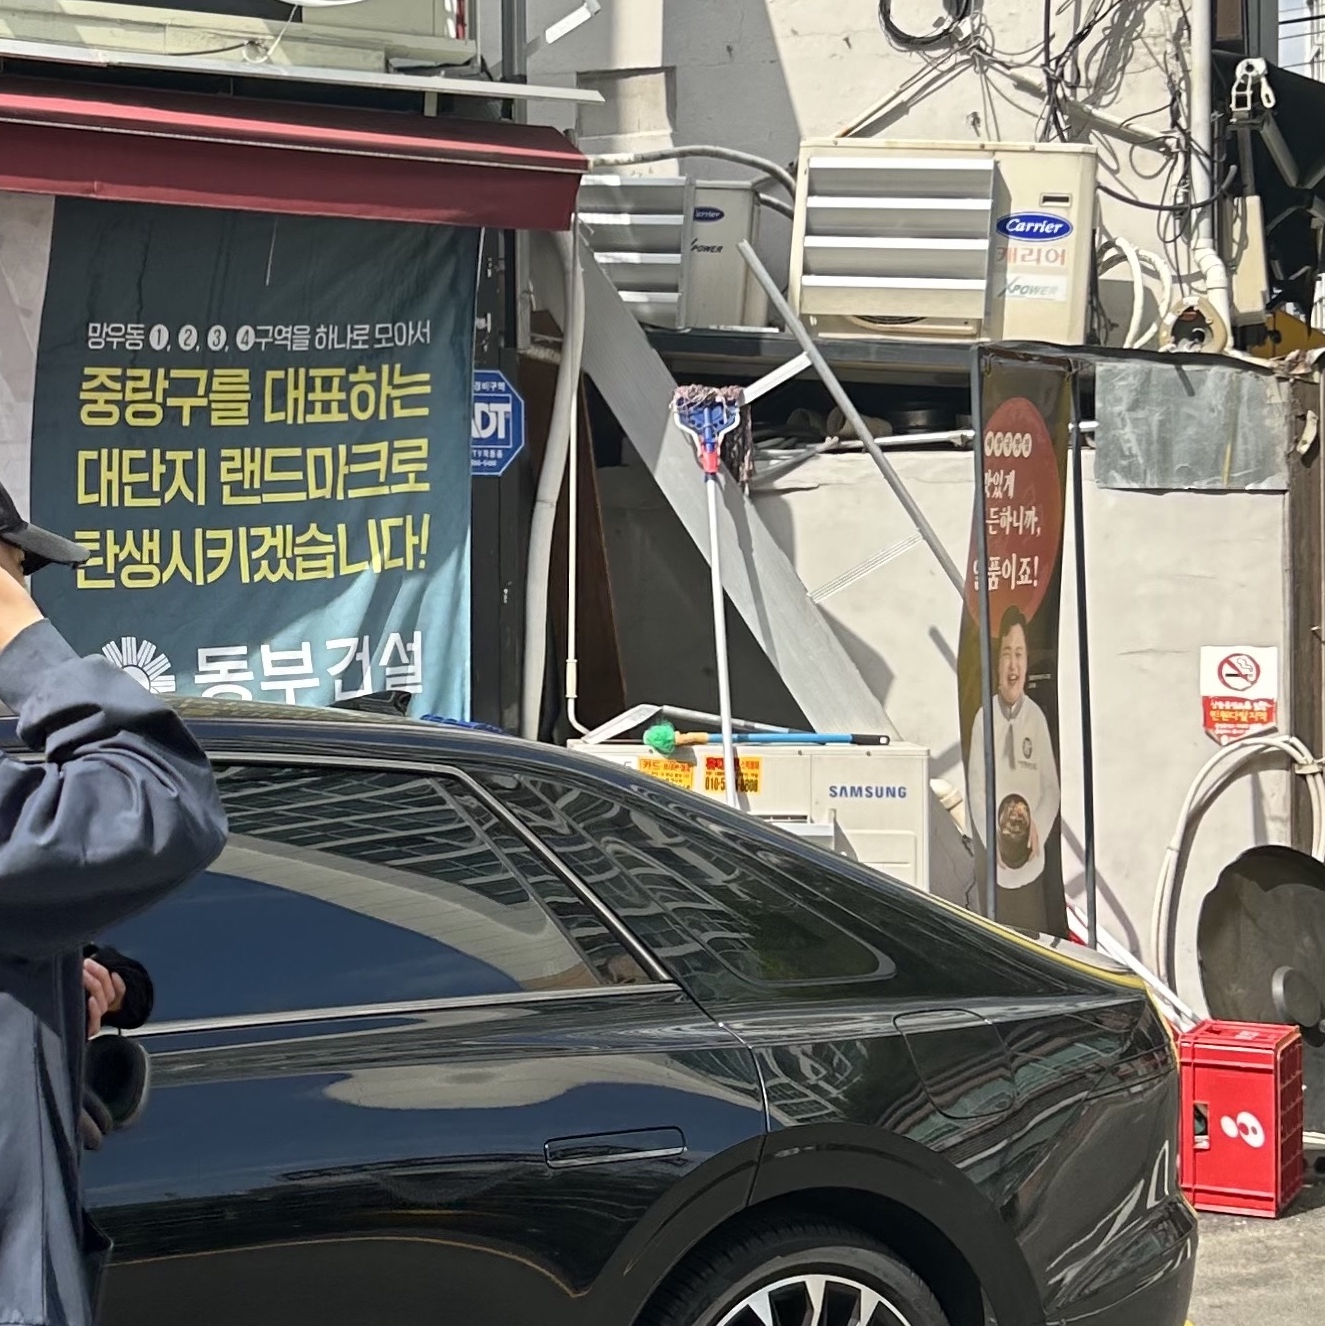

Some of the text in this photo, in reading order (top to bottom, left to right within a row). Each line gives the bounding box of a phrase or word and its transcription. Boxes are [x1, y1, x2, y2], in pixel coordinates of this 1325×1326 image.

[694, 210, 722, 218] arrier
[1006, 218, 1064, 234] Carrier
[88, 322, 146, 350] 망우동
[314, 324, 370, 350] 하나로
[373, 319, 431, 349] 모아서
[79, 363, 432, 427] 중랑구를 대표하는
[77, 438, 431, 507] 대단지 랜드마크로
[985, 505, 1042, 537] 든하니까,
[74, 514, 431, 589] 탄생시키겠습니다!
[194, 631, 424, 703] 동부건설
[829, 786, 907, 799] SAMSUNG
